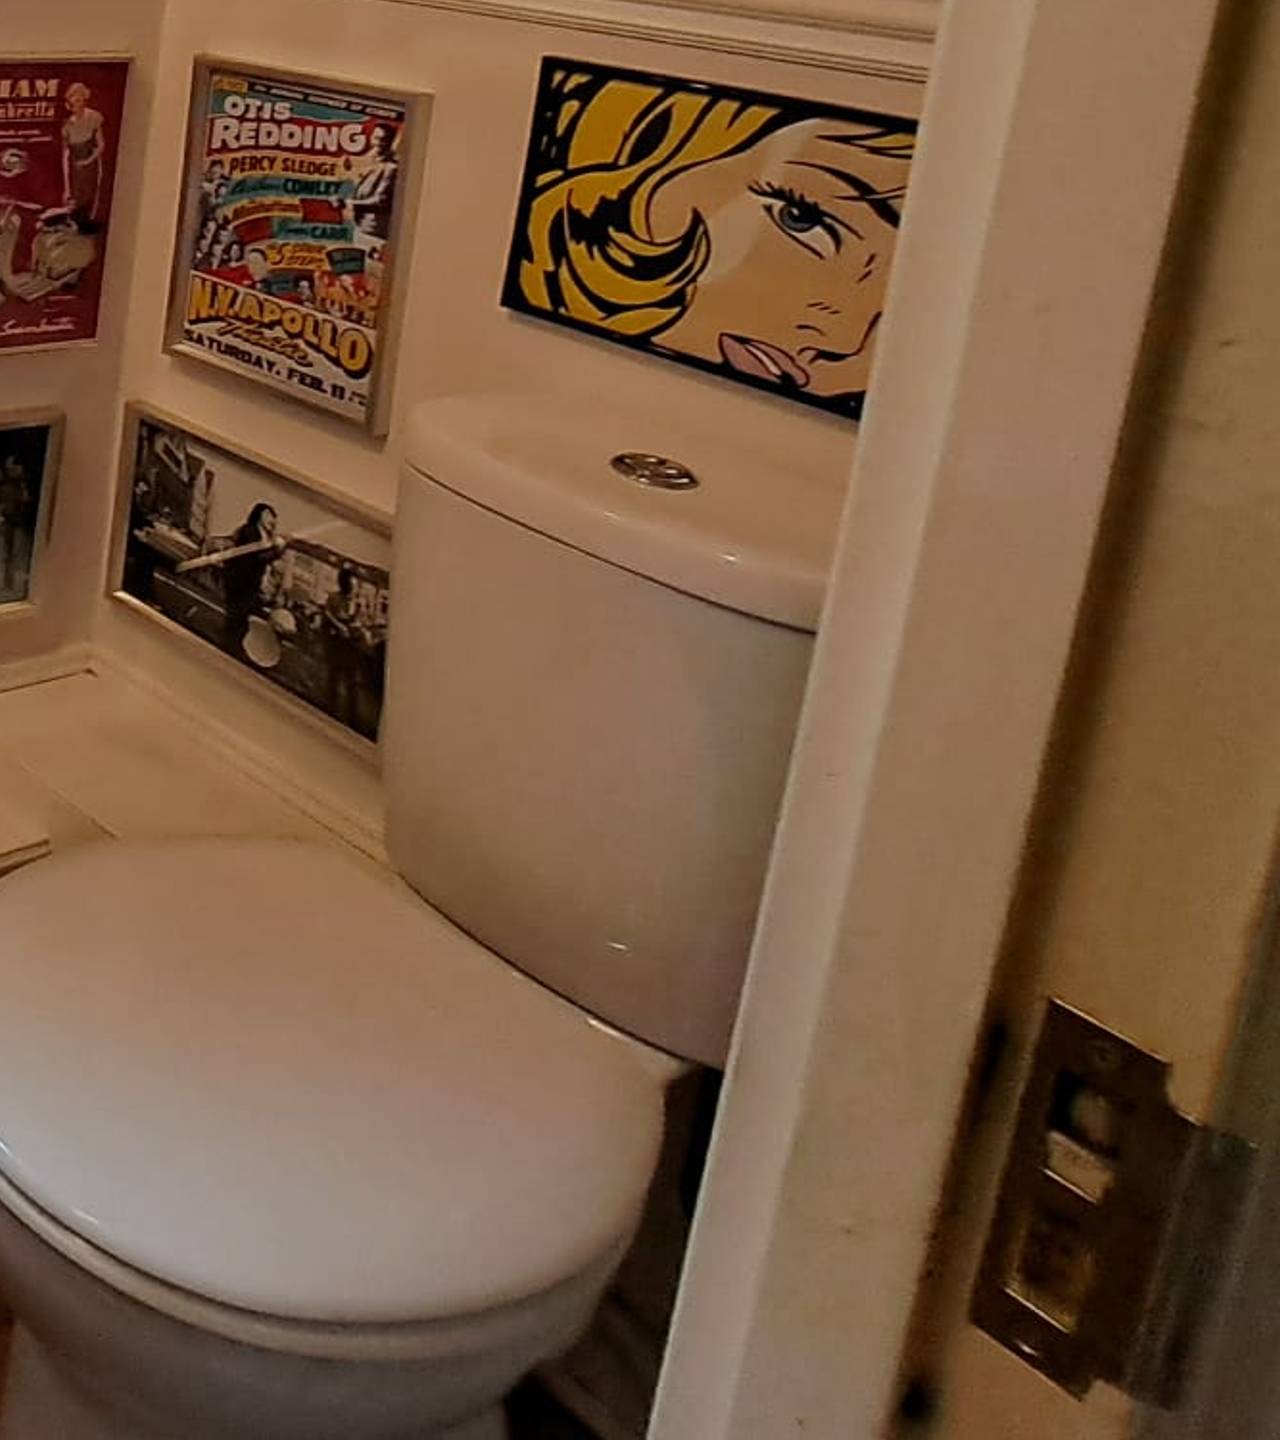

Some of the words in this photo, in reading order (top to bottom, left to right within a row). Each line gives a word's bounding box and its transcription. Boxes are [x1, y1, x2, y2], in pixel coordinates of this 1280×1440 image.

[223, 95, 292, 120] OTIS
[210, 117, 368, 153] REDDING
[228, 155, 278, 175] PERCY
[280, 157, 338, 176] SLEDGE
[238, 291, 373, 373] APOLLO
